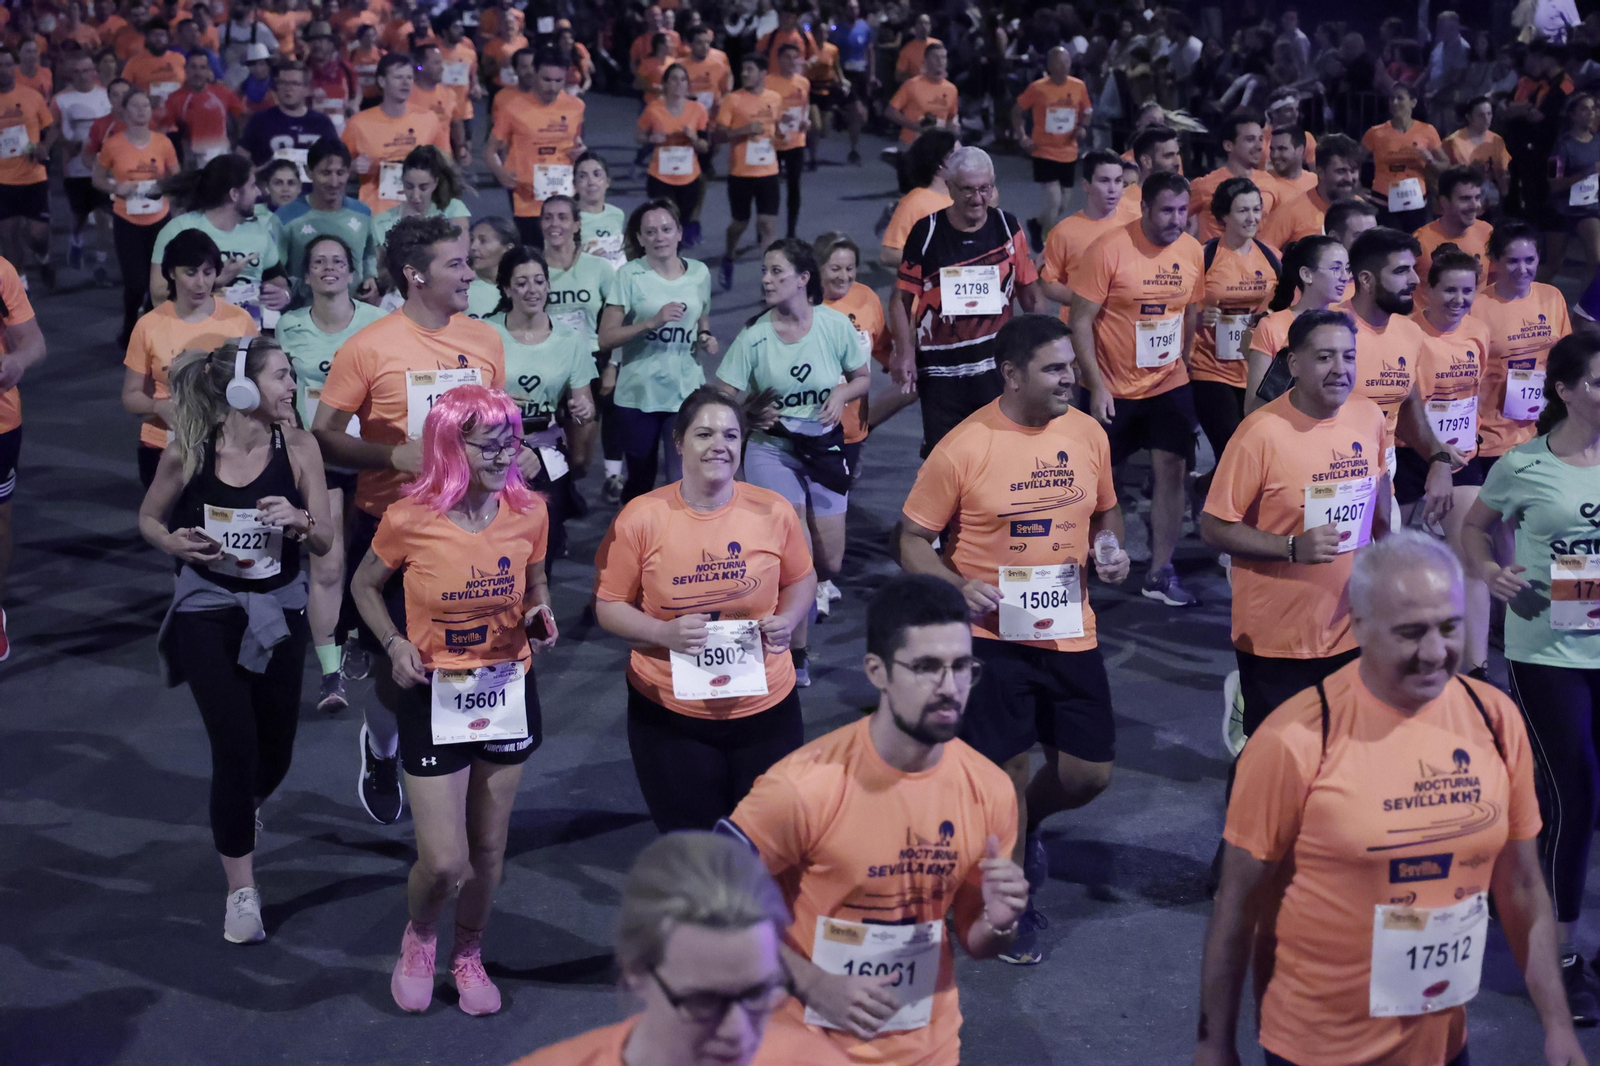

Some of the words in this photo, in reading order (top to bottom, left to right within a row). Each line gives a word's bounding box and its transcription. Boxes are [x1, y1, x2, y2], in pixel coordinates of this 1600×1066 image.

[954, 282, 989, 296] 21798
[547, 289, 591, 304] ano
[1520, 324, 1552, 332] NOCTURNA
[1149, 332, 1176, 348] 17981
[1228, 330, 1244, 341] 18
[1508, 332, 1536, 341] SEVILLA
[1450, 363, 1479, 371] NOCTURNA
[1435, 370, 1463, 379] SEVILLA
[1521, 387, 1544, 400] 179
[1438, 417, 1470, 432] 17979
[1330, 459, 1368, 470] NOCTURNA
[1031, 470, 1074, 478] NOCTURNA
[1312, 470, 1349, 482] SEVILLA
[1351, 467, 1368, 477] KH7
[1010, 480, 1051, 492] SEVILLA
[1053, 478, 1074, 487] KH7
[1325, 503, 1365, 523] 14207
[223, 532, 271, 550] 12227
[696, 561, 746, 572] NOCTURNA
[466, 575, 515, 589] NOCTURNA
[672, 573, 720, 585] SEVILLA
[722, 569, 746, 580] KH7
[441, 589, 490, 601] SEVILLA
[492, 584, 515, 596] KH7
[1020, 590, 1068, 609] 15084
[696, 647, 746, 667] 15902
[454, 689, 506, 710] 15601
[1414, 776, 1480, 792] NOCTURNA
[1383, 793, 1447, 811] SEVILLA
[1450, 789, 1481, 803] KH7
[899, 848, 958, 860] NOCTURNA
[868, 863, 924, 877] SEVILLA
[926, 864, 955, 876] KH7
[1407, 936, 1472, 970] 17512
